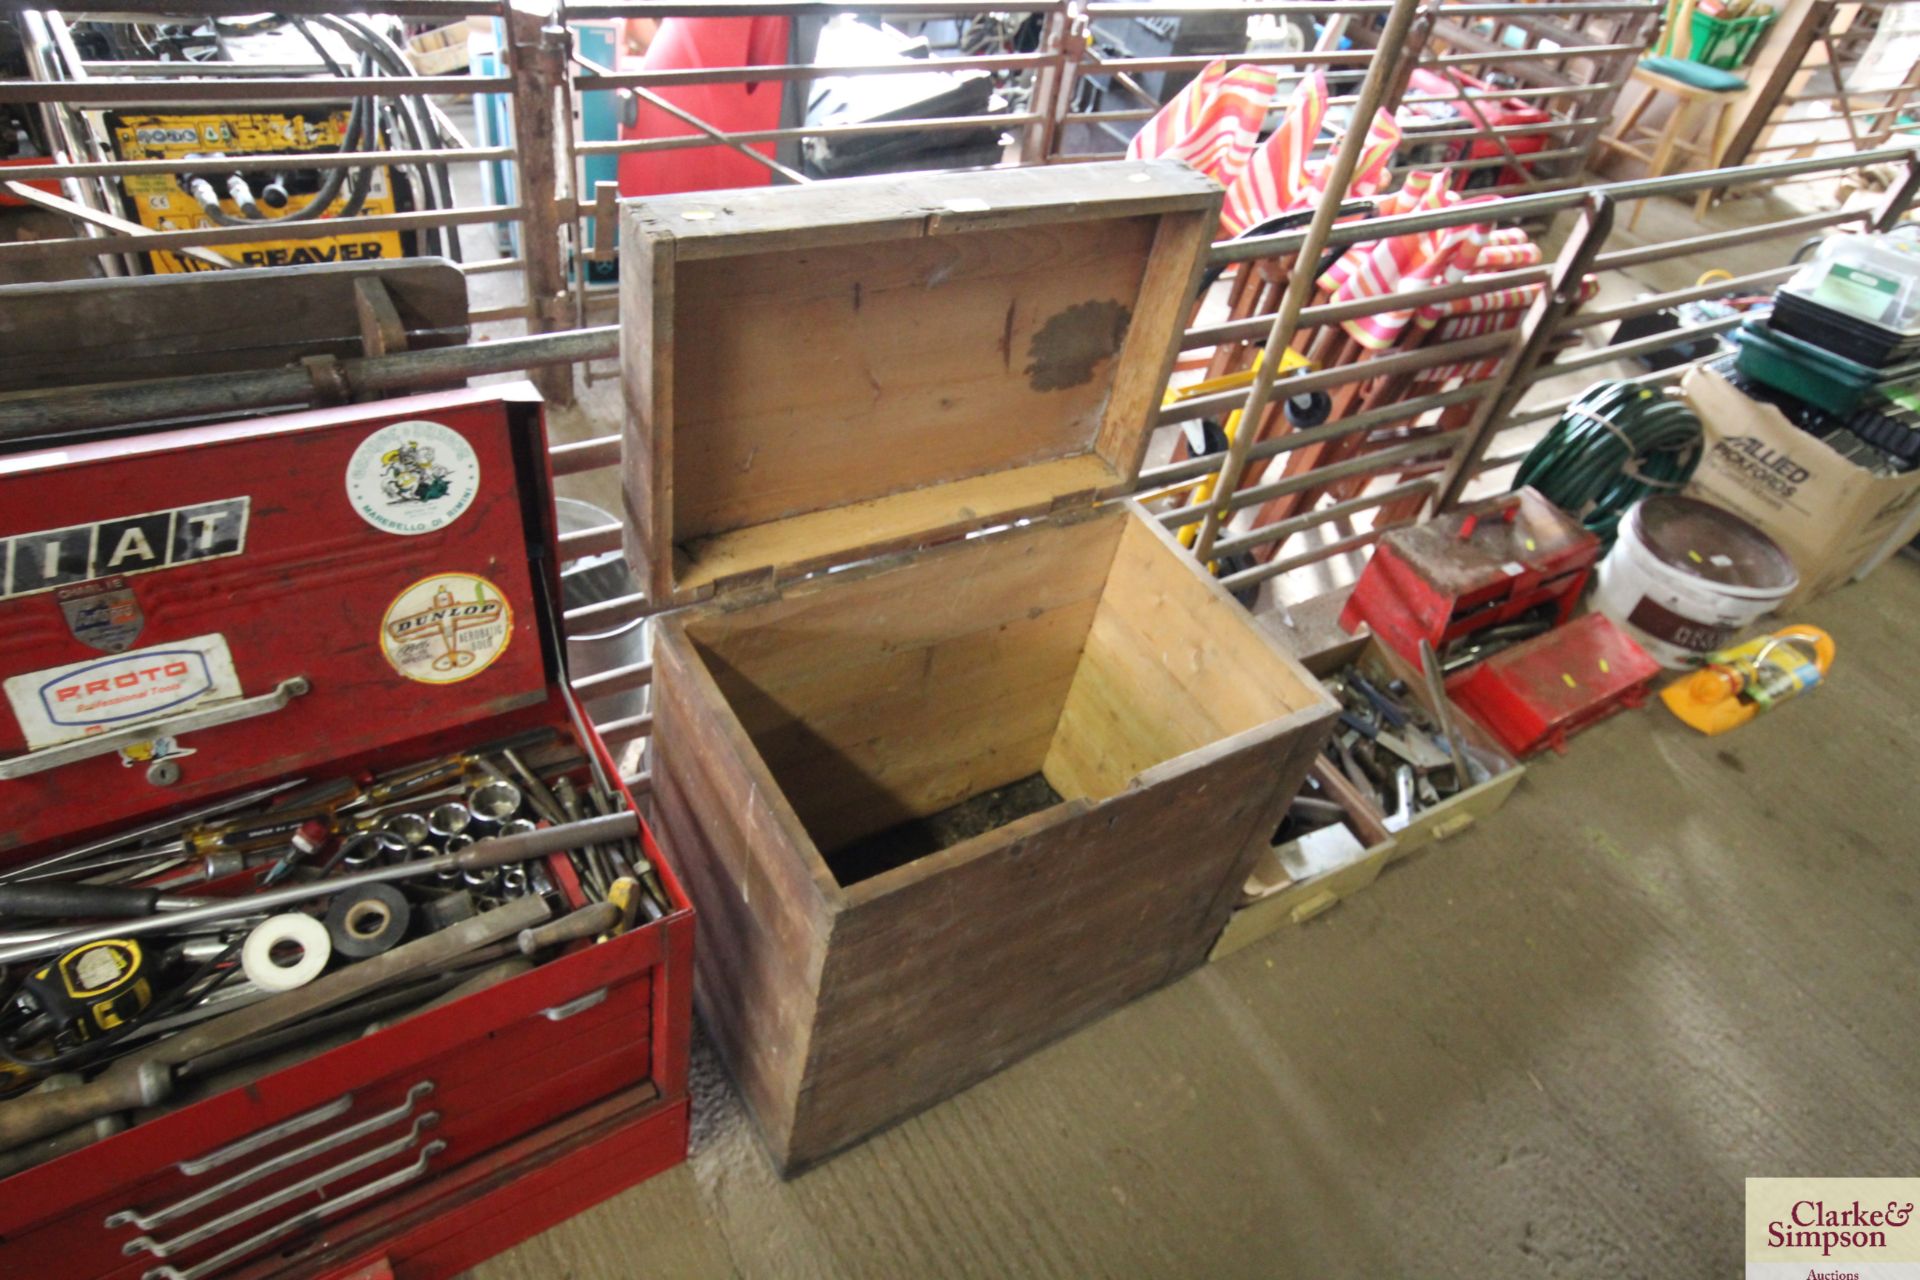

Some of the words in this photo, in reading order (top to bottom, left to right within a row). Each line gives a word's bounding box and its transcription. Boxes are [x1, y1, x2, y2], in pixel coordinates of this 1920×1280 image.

[242, 242, 383, 268] BEAVER
[1723, 436, 1810, 484] ALLIED
[362, 504, 426, 531] MAREBELLO
[446, 487, 473, 517] RIMINI
[398, 604, 496, 632] DUNLOP
[55, 661, 189, 702] PROTO
